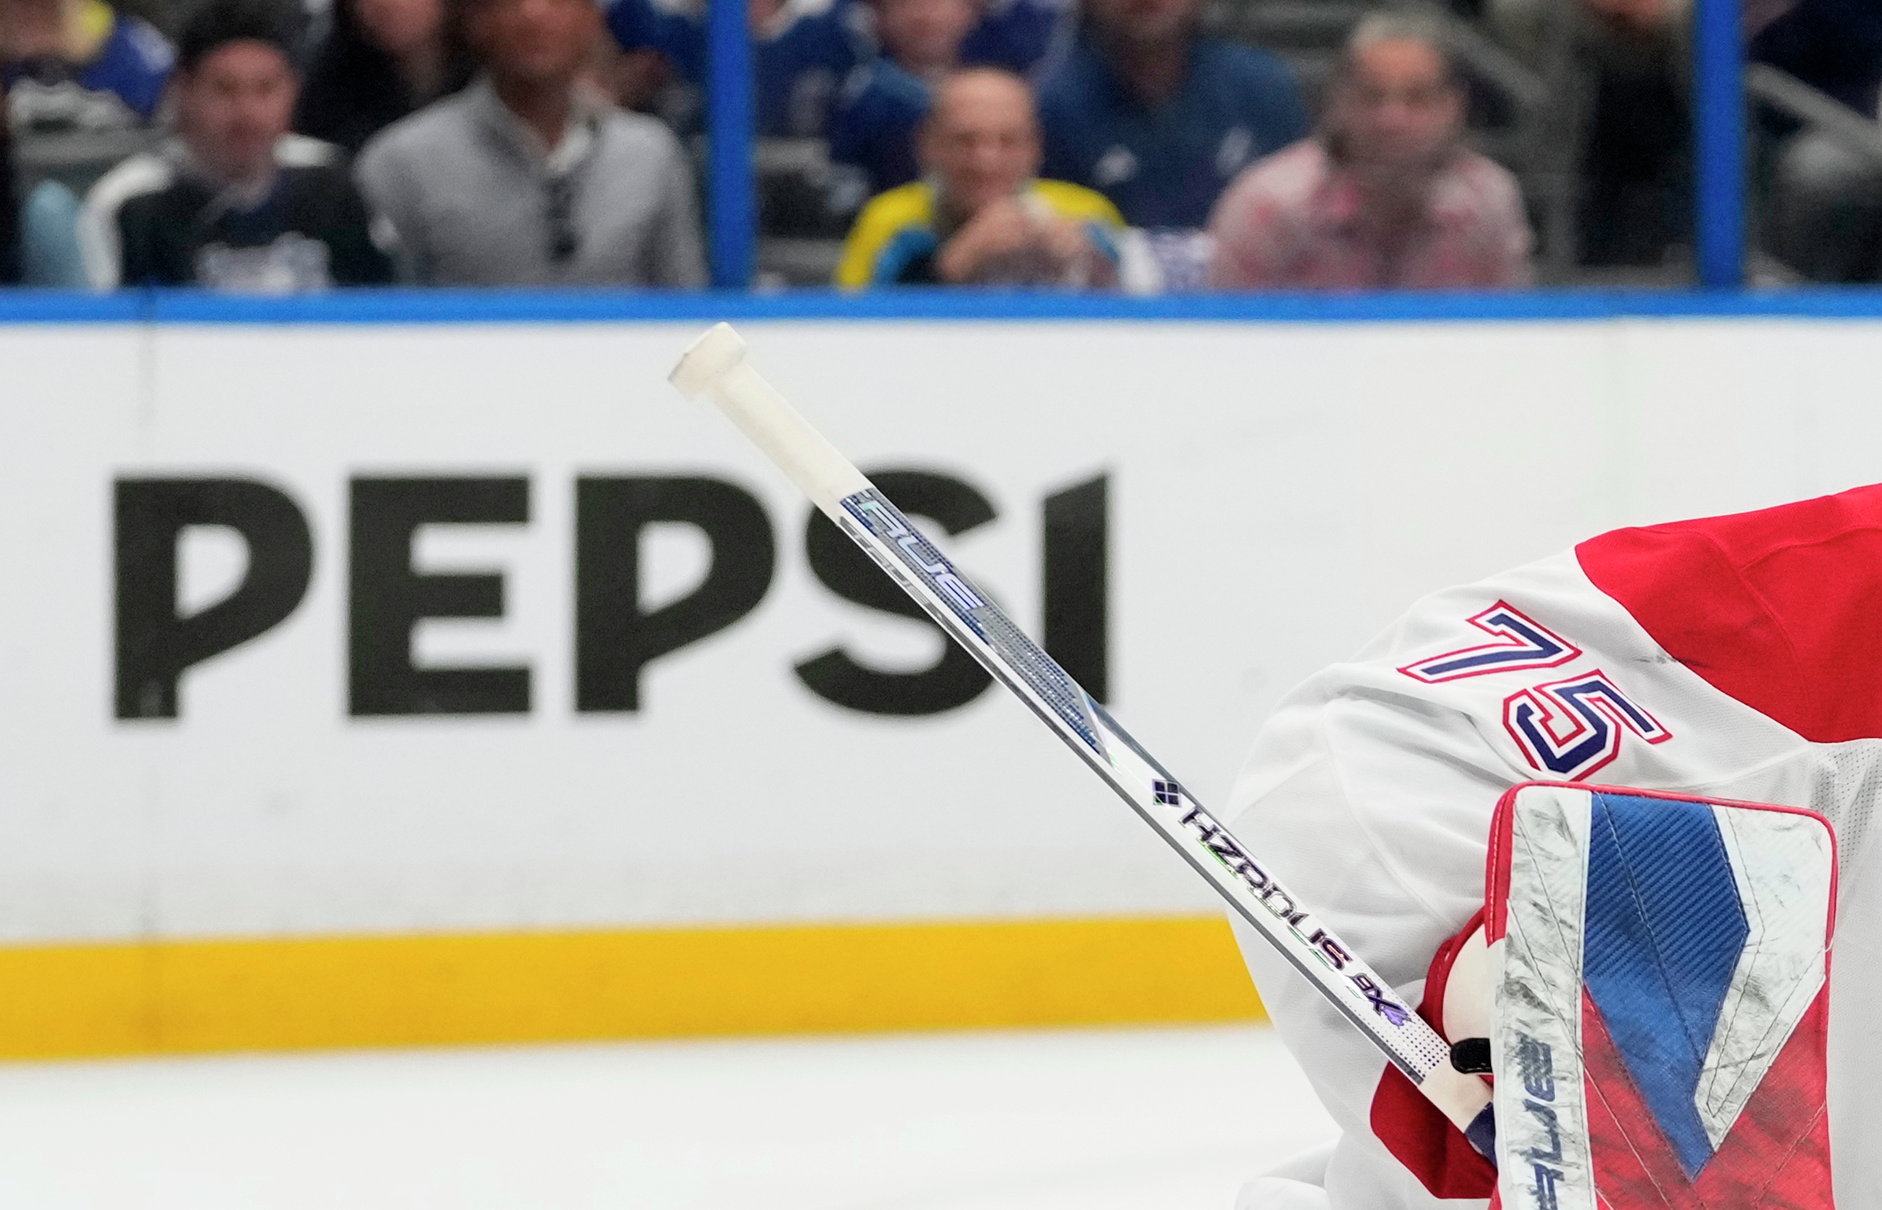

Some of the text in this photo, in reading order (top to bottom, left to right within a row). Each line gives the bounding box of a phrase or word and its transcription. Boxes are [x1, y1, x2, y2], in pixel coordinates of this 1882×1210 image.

[113, 468, 1110, 721] PEPSI
[857, 490, 986, 611] RUE
[1396, 598, 1673, 782] 75
[1178, 807, 1353, 974] HZRDUS
